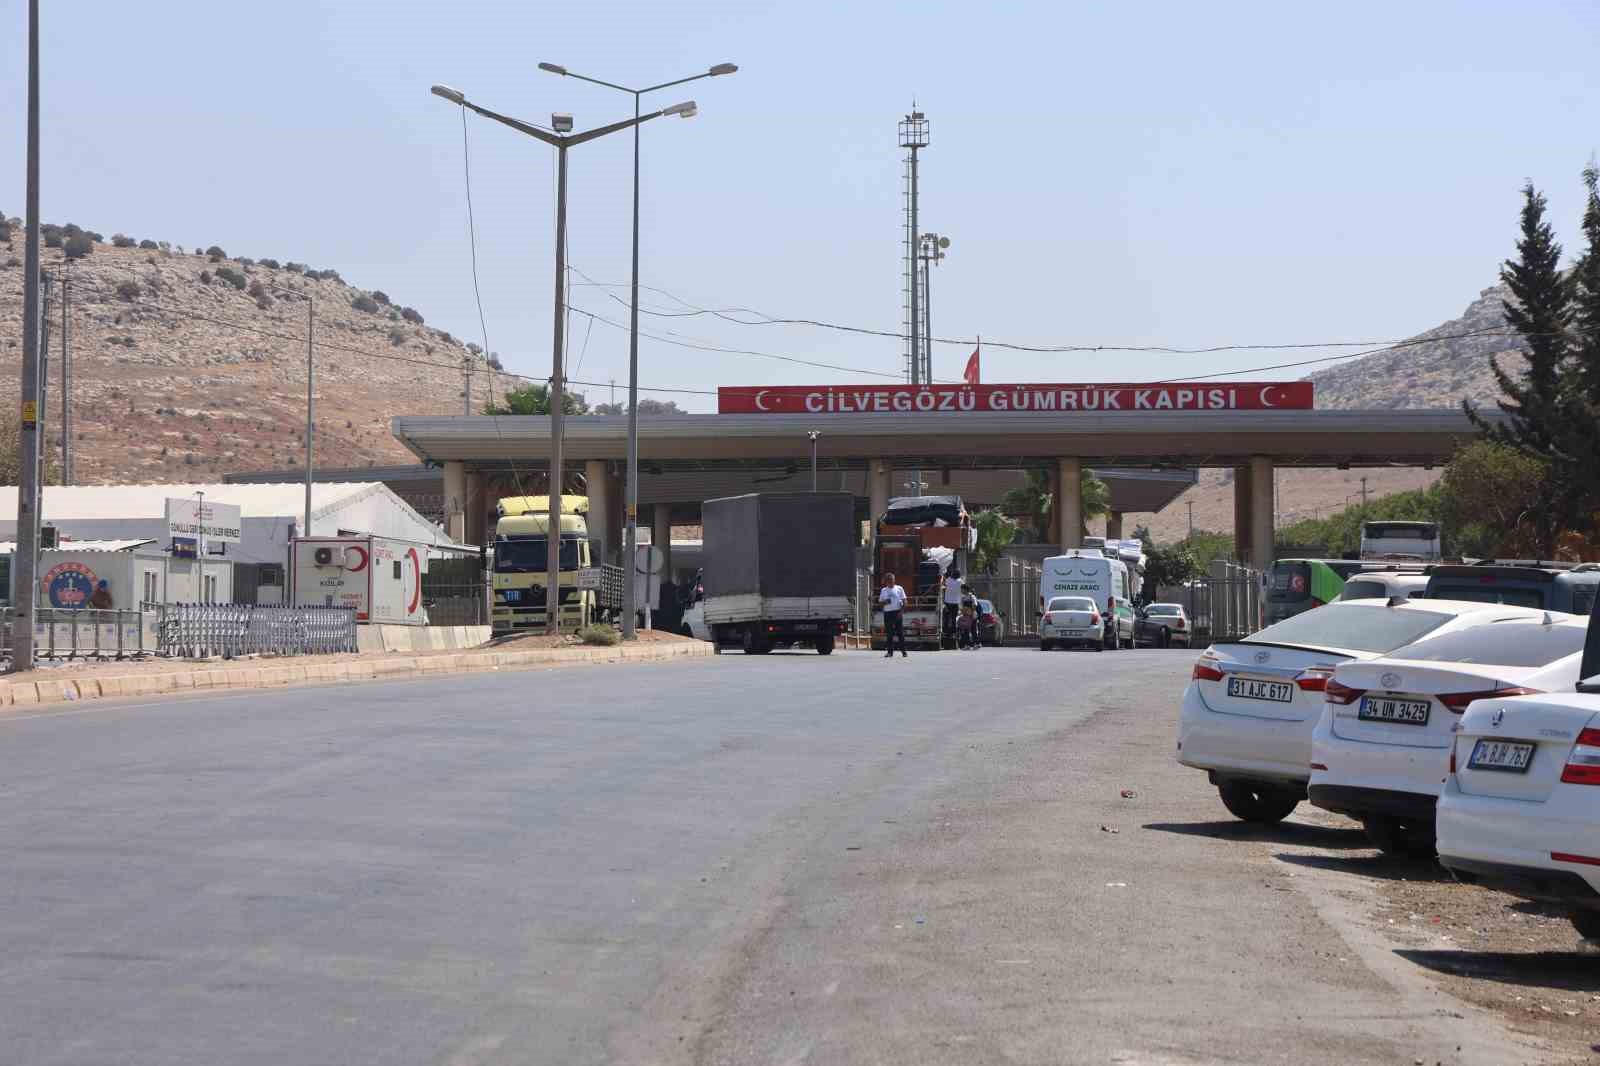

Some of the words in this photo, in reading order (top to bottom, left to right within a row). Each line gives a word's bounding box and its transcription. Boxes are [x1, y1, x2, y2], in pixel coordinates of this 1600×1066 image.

[805, 386, 976, 412] CİLVEGÖZÜ
[988, 385, 1121, 410] GÜMRÜK
[1134, 389, 1236, 409] KAPISI
[1054, 584, 1078, 592] CENAZE
[1079, 584, 1101, 592] ARACI
[1233, 680, 1245, 696] 31
[1249, 682, 1267, 698] AJC
[1270, 684, 1288, 701] 617
[1367, 700, 1378, 716] 34
[1382, 701, 1396, 718] UN
[1398, 703, 1426, 721] 3425
